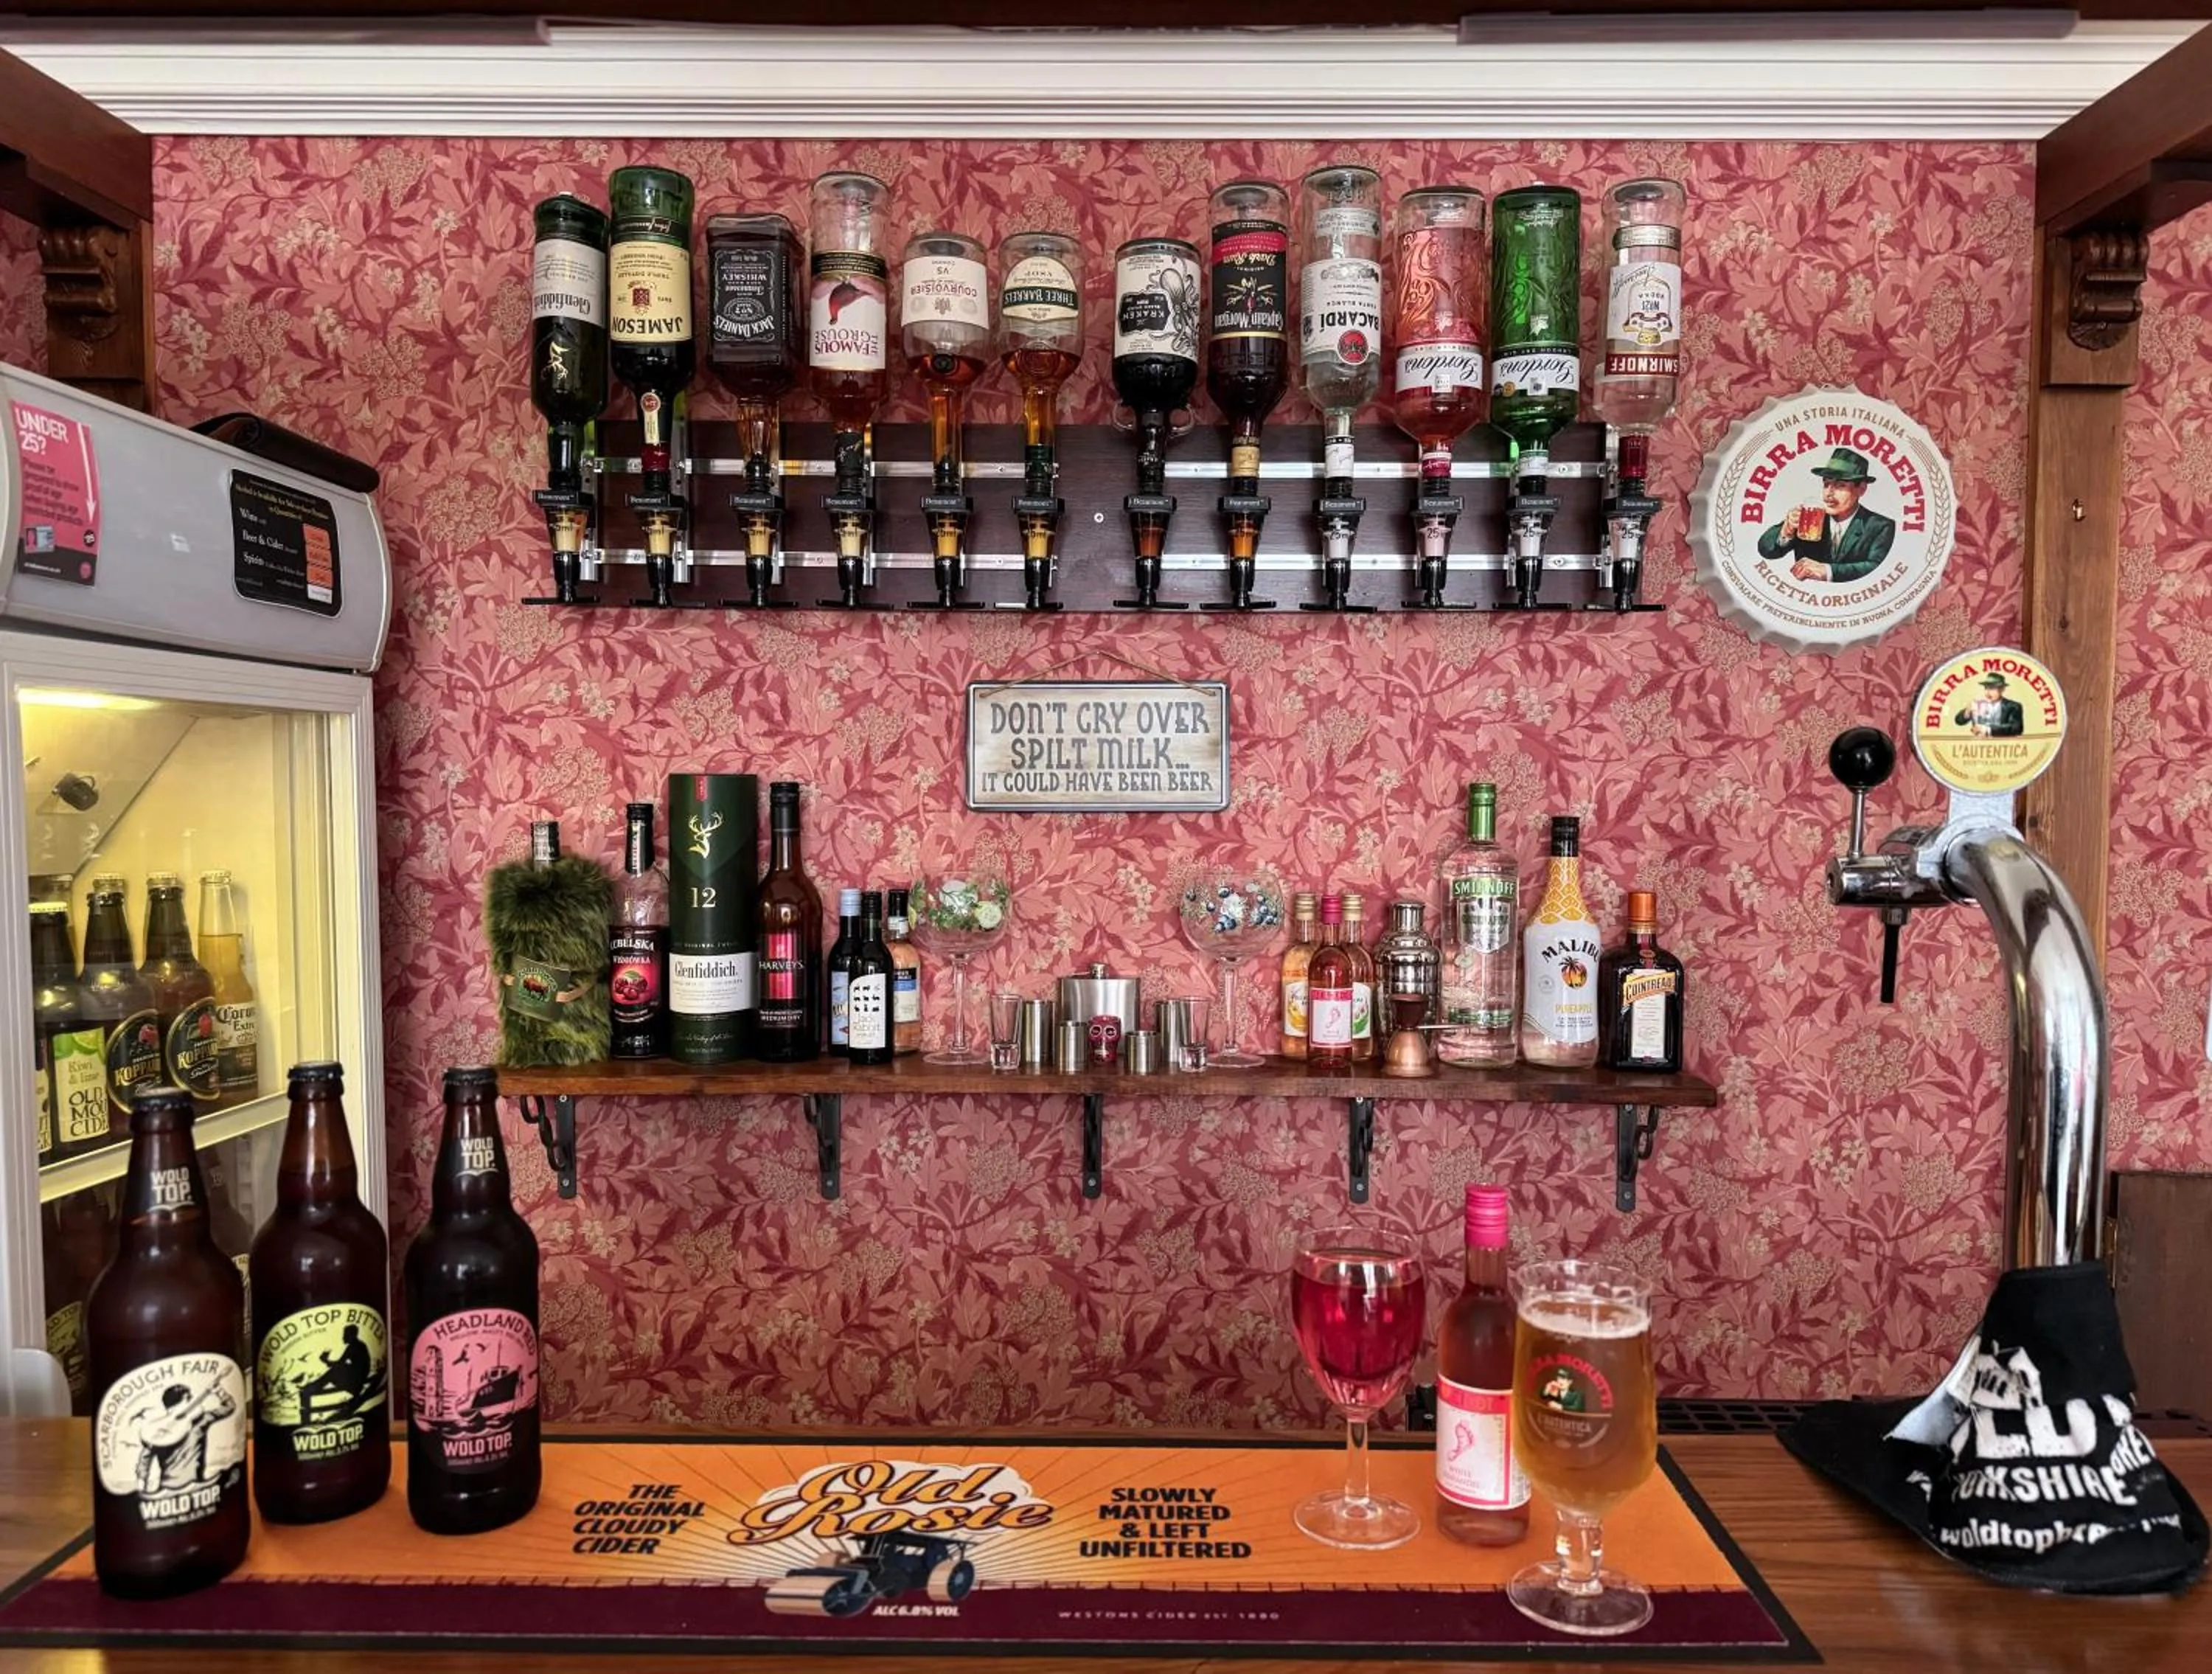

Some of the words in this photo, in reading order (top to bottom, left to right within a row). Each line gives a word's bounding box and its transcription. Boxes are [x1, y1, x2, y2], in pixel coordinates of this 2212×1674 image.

[910, 282, 978, 296] COURVOISIER
[1004, 288, 1043, 305] BARRELS
[1046, 290, 1075, 306] THREE
[1122, 310, 1164, 320] KRAKEN
[1320, 310, 1380, 333] BACARDÍ
[612, 316, 683, 334] JAMESON
[751, 315, 775, 335] JACK
[813, 328, 871, 344] GROUSE
[814, 340, 871, 355] FAMOUS
[1403, 355, 1478, 382] Gordon's
[1499, 358, 1574, 383] Gordon's
[1610, 357, 1678, 373] SMIRNOFF
[13, 406, 70, 444] UNDER
[1775, 414, 1800, 431] UNA
[1804, 406, 1848, 422] STORIA
[1851, 407, 1906, 440] ITALIANA
[19, 430, 47, 456] 25?
[1740, 429, 1818, 525] BIRRA
[1823, 424, 1926, 533] MORETTI
[1753, 559, 1818, 606] RICETTA
[1821, 561, 1909, 608] ORIGINALE
[1721, 560, 1763, 610] CONSUMARE
[1762, 603, 1847, 628] PREFERIBILMENTE
[1849, 619, 1860, 628] IN
[1863, 608, 1894, 625] BUONA
[1893, 569, 1937, 610] COMPAGNIA
[1926, 664, 1979, 729] BIRRA
[1982, 659, 2057, 726] MORETTI
[991, 701, 1067, 734] DON'T
[1076, 701, 1127, 734] CRY
[1136, 701, 1210, 734] OVER
[1011, 737, 1088, 770] SPILT
[1096, 737, 1189, 770] MILK...
[1952, 744, 2028, 759] L'AUTENTICA
[981, 772, 998, 793] IT
[1004, 772, 1060, 793] COULD
[1065, 772, 1113, 793] HAVE
[1118, 772, 1161, 793] BEEN
[1168, 772, 1213, 793] BEER
[1453, 880, 1515, 895] SMIRNOFF
[690, 886, 717, 909] 12
[675, 960, 736, 979] Glenfiddich
[69, 1086, 103, 1105] OLD
[461, 1136, 494, 1152] WOLD
[152, 1167, 189, 1185] WOLD
[301, 1309, 342, 1328] TOP
[434, 1313, 525, 1340] HEADLAND
[102, 1364, 175, 1469] SCARBOROUGH
[181, 1359, 220, 1375] FAIR
[293, 1431, 337, 1452] WOLD
[442, 1438, 485, 1457] WOLD
[628, 1484, 683, 1500] THE
[797, 1459, 1007, 1506] Old
[1110, 1487, 1217, 1503] SLOWLY
[139, 1497, 189, 1521] WOLD
[574, 1501, 706, 1518] ORIGINAL
[727, 1491, 1054, 1544] Rosie
[1098, 1505, 1231, 1521] MATURED
[573, 1518, 692, 1535] CLOUDY
[1119, 1523, 1141, 1538] &
[1149, 1523, 1211, 1539] LEFT
[572, 1538, 661, 1555] CIDER
[1079, 1541, 1252, 1558] UNFILTERED
[935, 1605, 960, 1617] VOL
[1058, 1611, 1139, 1619] WESTONS
[1146, 1611, 1197, 1619] CIDER
